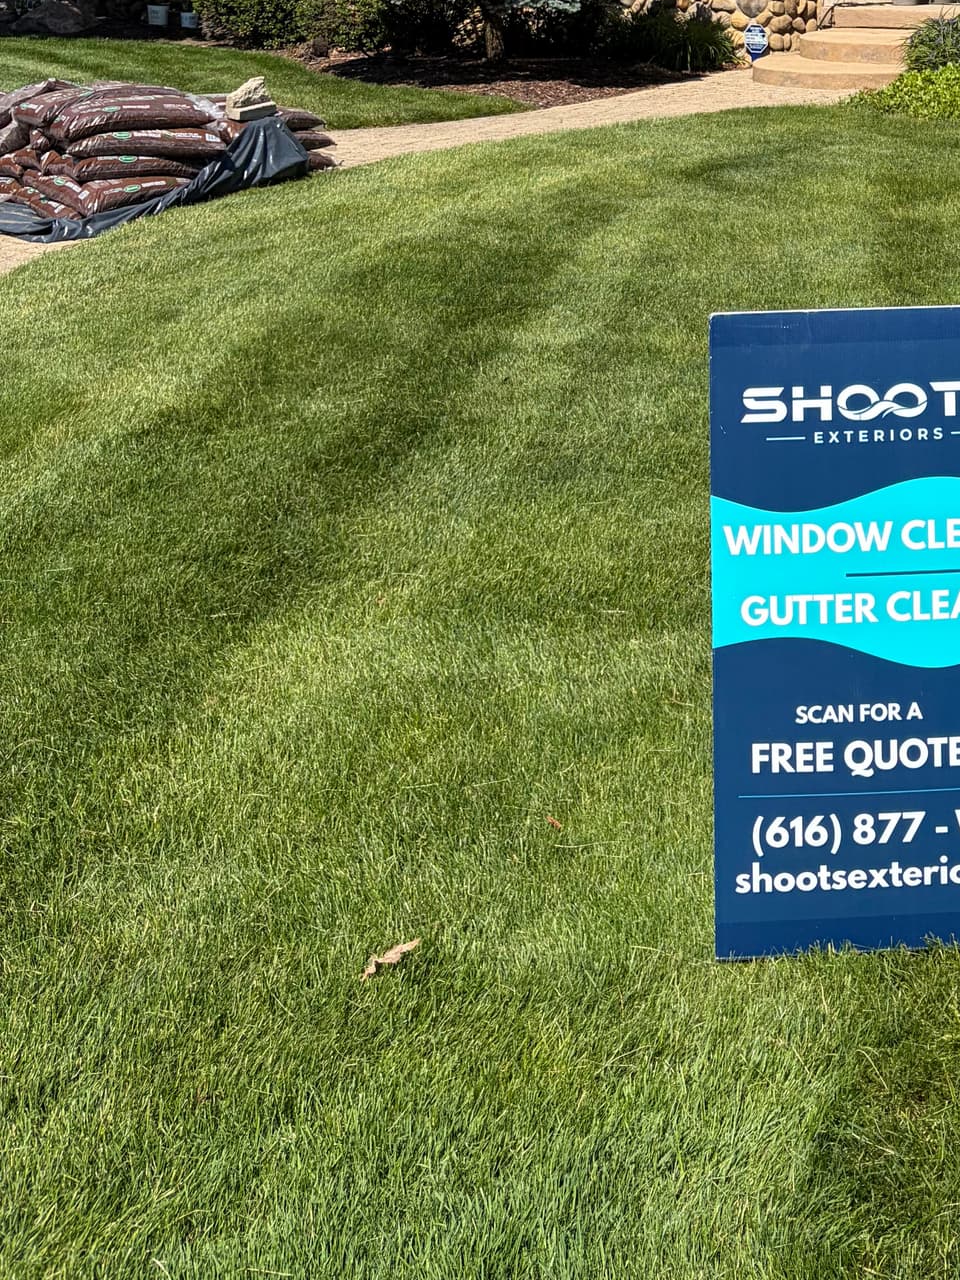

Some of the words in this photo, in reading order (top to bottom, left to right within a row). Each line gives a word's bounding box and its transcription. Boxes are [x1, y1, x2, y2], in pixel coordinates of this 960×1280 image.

[814, 427, 943, 444] EXTERIORS
[723, 521, 893, 556] WINDOW
[741, 593, 879, 627] GUTTER
[795, 705, 854, 724] SCAN
[859, 703, 903, 722] FOR
[906, 701, 924, 720] A
[751, 742, 834, 774] FREE
[752, 814, 842, 857] (616)
[853, 811, 926, 845] 877
